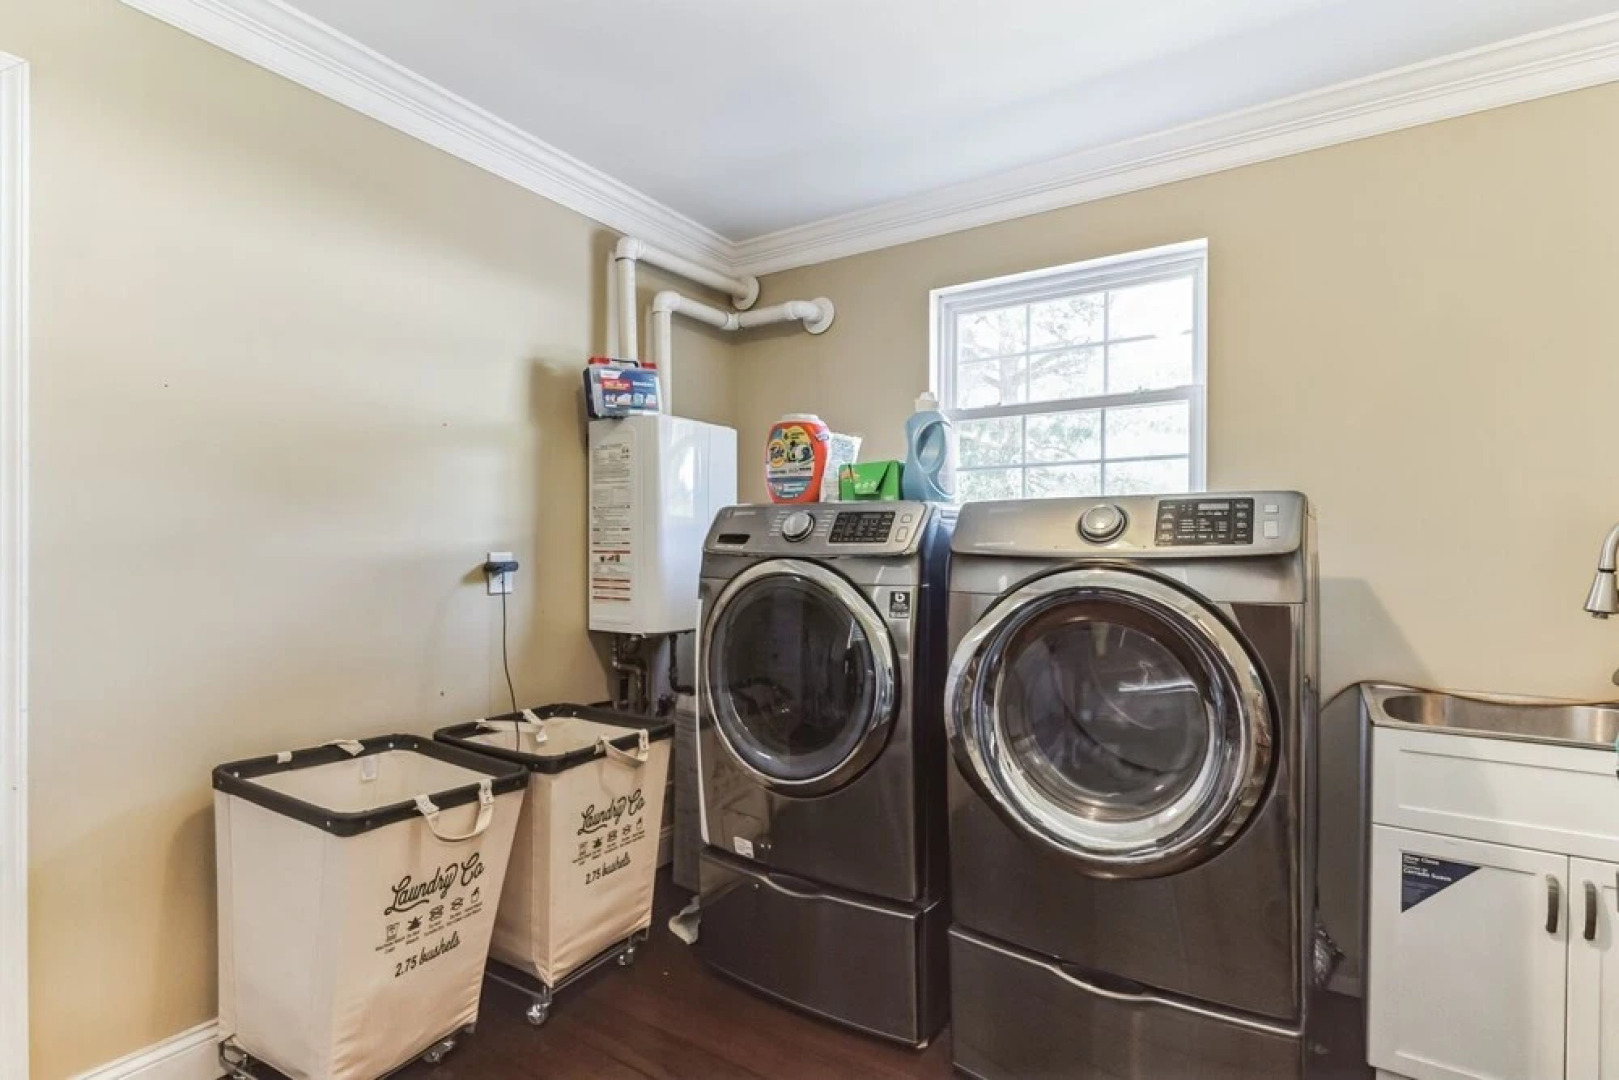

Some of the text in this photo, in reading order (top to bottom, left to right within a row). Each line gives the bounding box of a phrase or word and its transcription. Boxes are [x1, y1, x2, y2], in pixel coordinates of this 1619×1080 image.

[577, 788, 646, 836] Laundry Co
[384, 852, 484, 915] Laundry Co
[601, 851, 630, 876] bushels
[395, 954, 418, 978] 2.75
[418, 930, 461, 965] bushels
